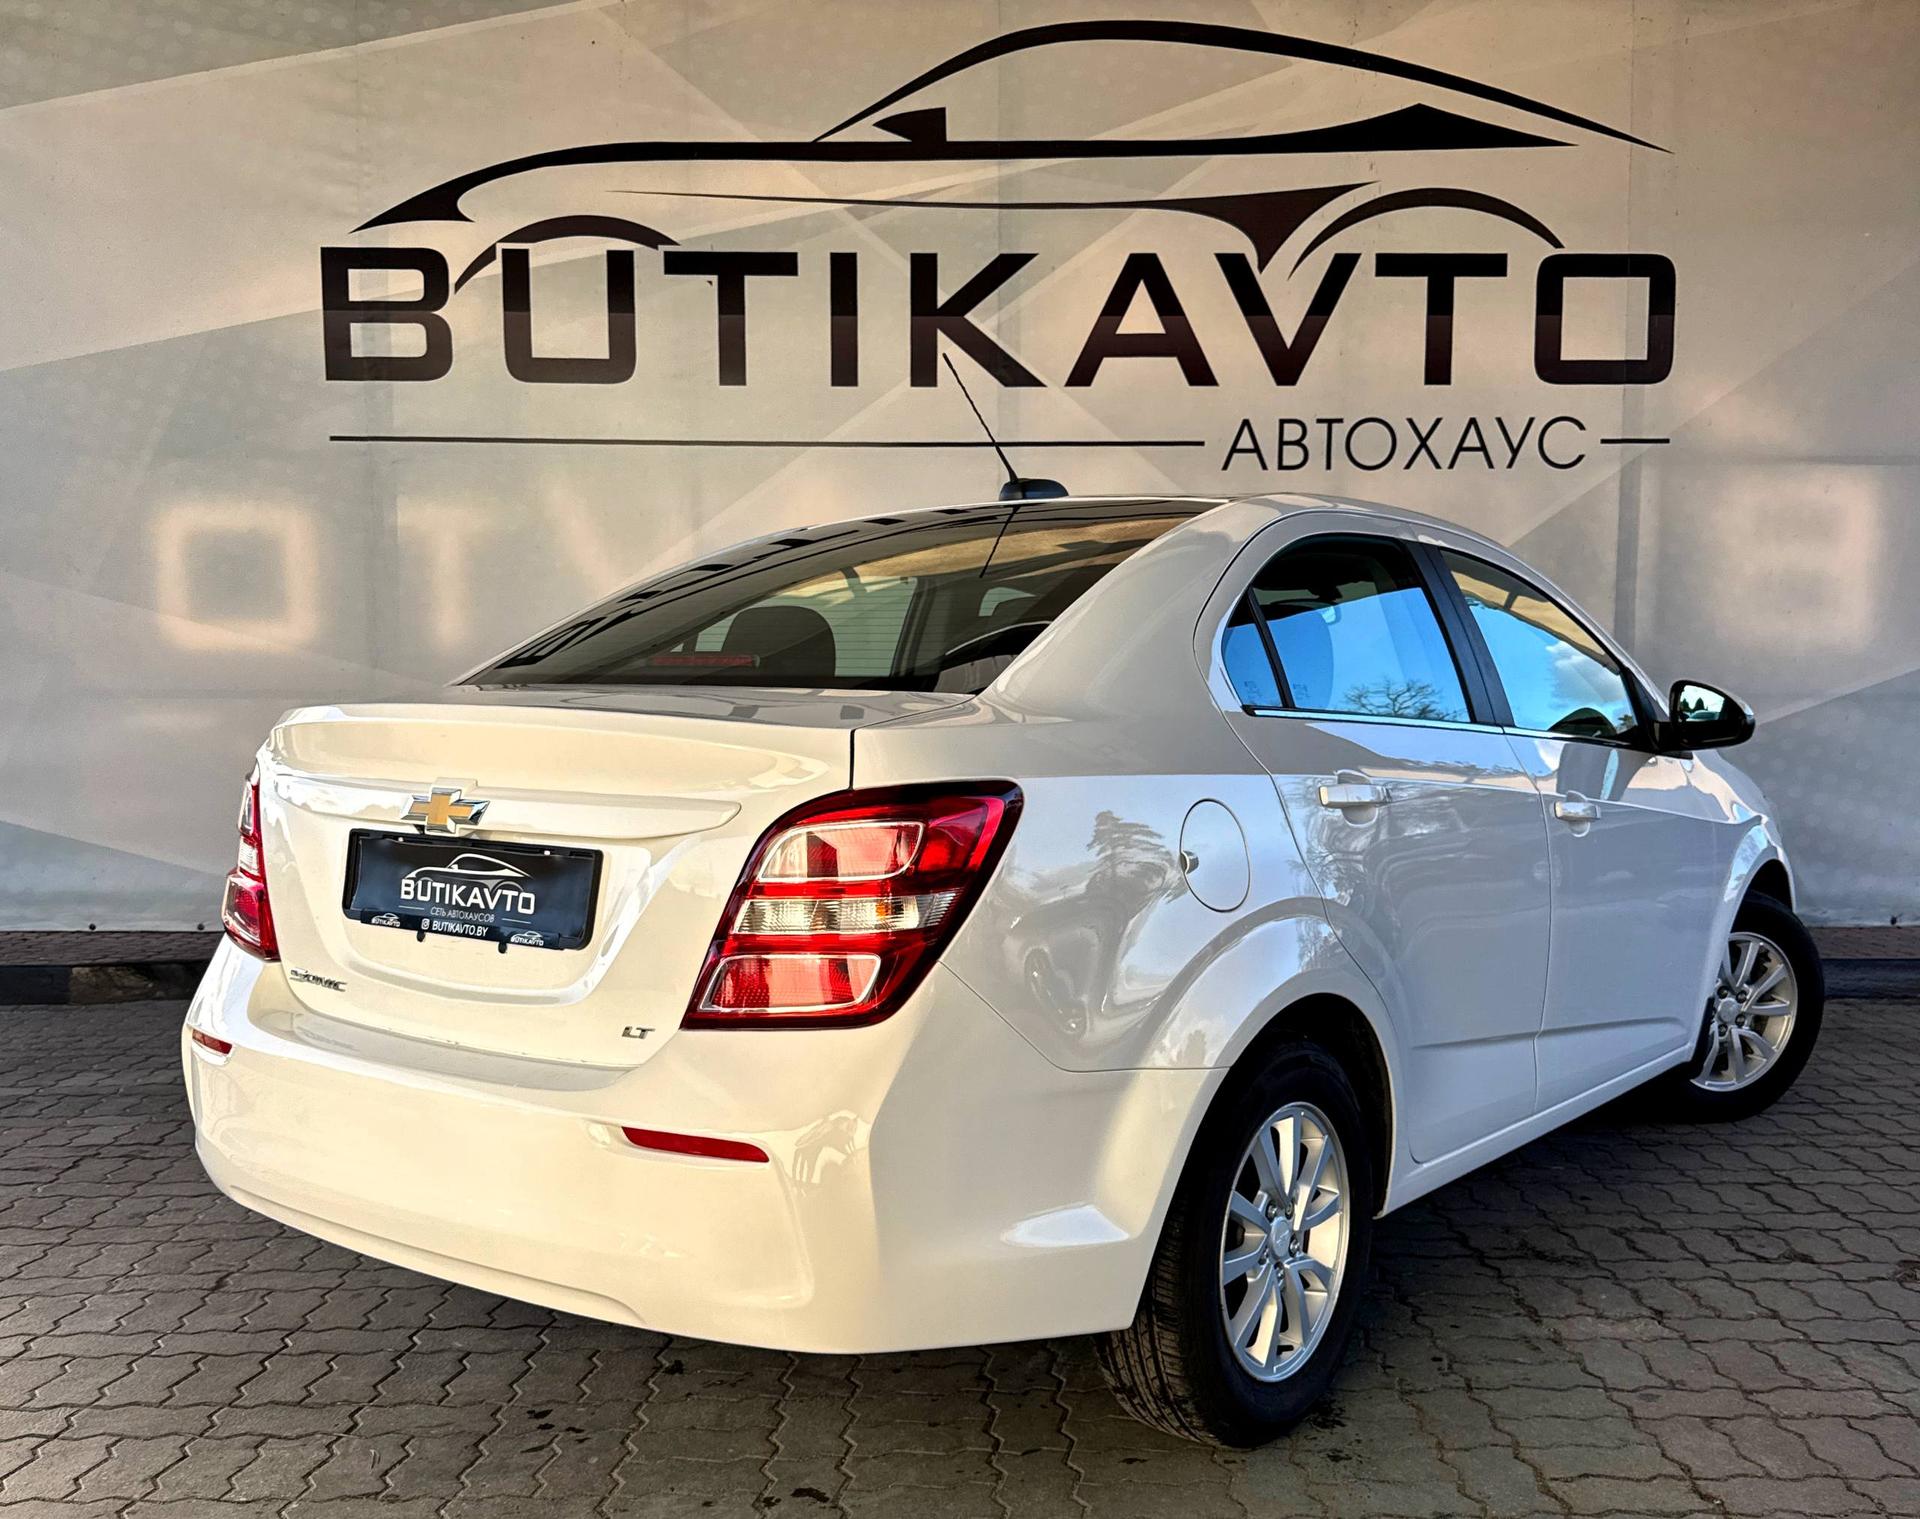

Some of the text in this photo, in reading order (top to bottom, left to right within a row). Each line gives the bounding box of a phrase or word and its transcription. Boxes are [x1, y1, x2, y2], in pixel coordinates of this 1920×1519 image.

[320, 247, 1676, 388] BUTIKAVTO
[1220, 416, 1587, 471] АВТОХАУС
[400, 878, 536, 915] BUTIKAVTO
[430, 906, 495, 923] СЕТЬ АВТОХАУСОВ
[432, 920, 488, 936] BUTIKAVTO.BY
[621, 1026, 656, 1039] LT
